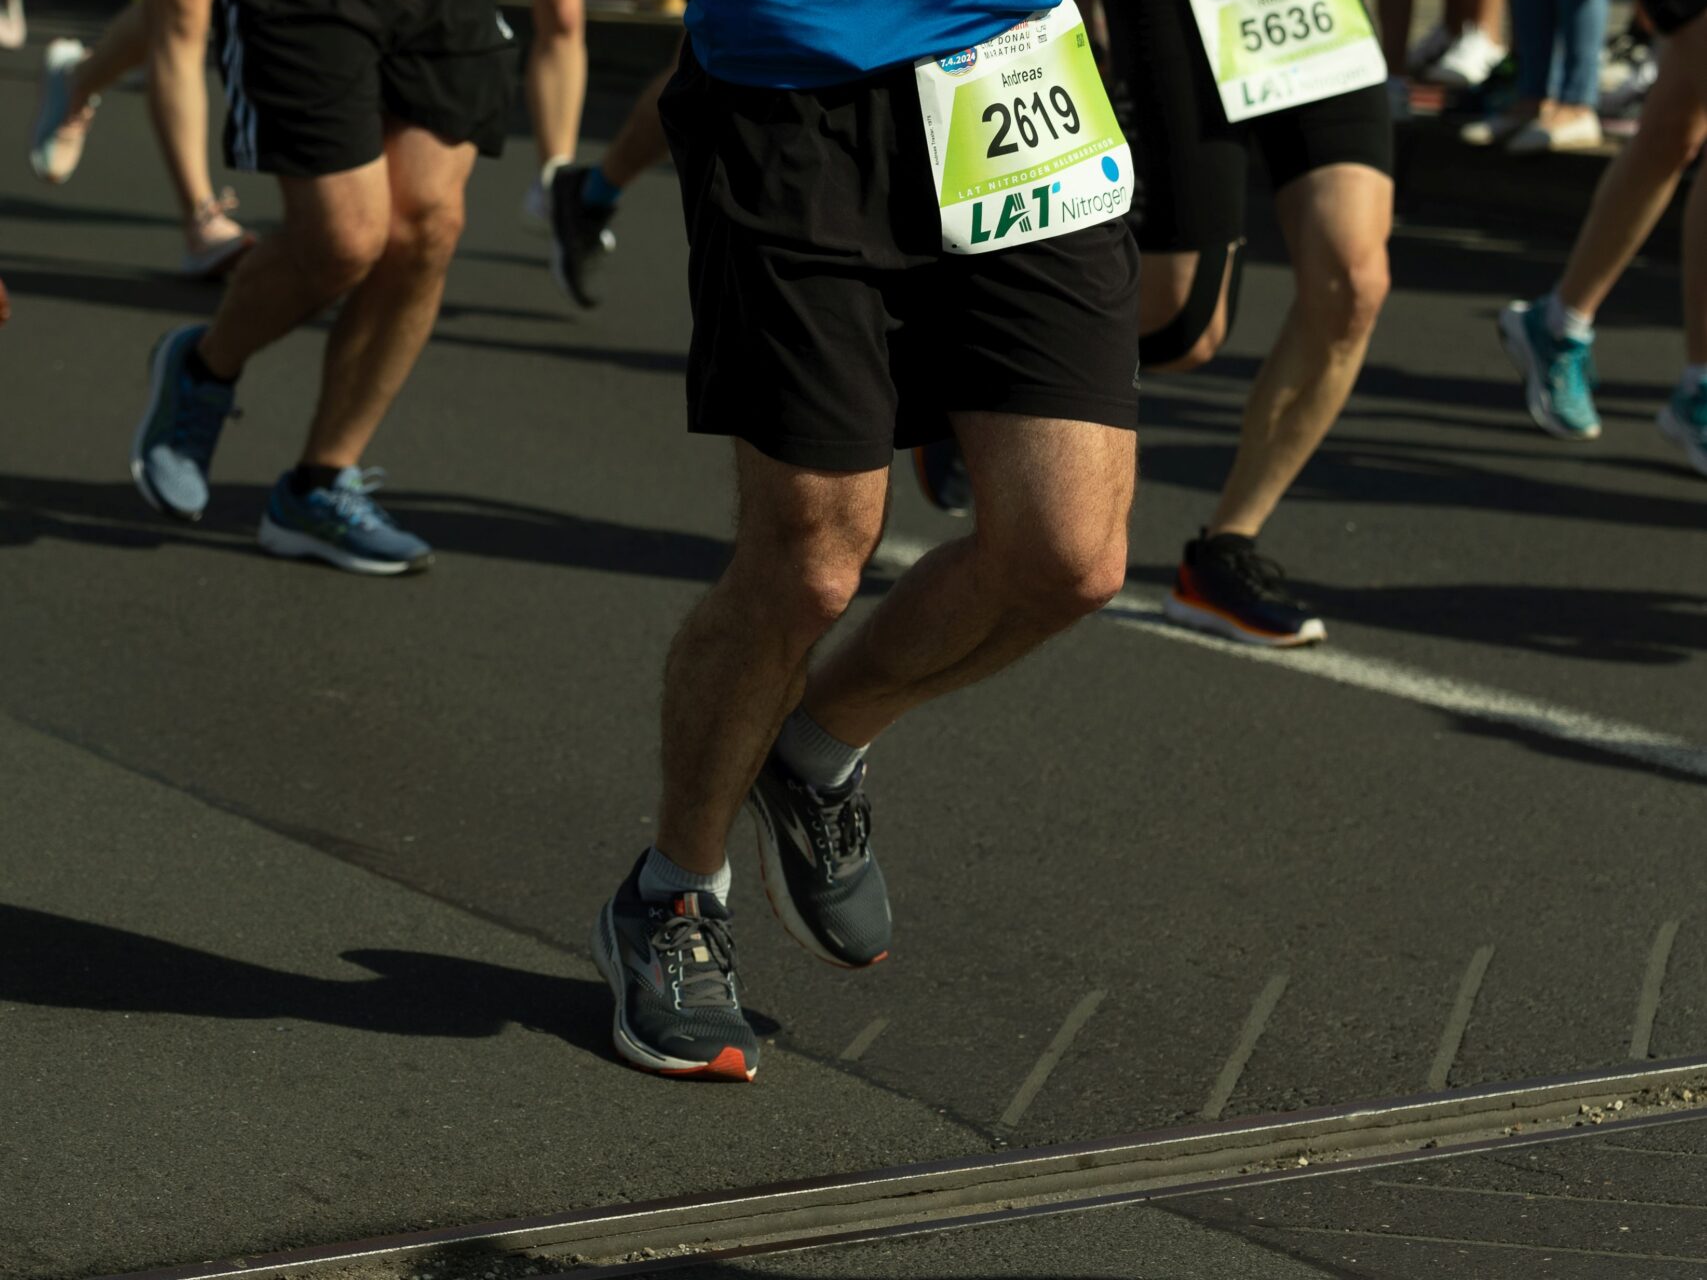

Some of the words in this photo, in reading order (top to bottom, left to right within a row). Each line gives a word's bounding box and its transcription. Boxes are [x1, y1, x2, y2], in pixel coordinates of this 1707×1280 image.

[998, 31, 1030, 45] DONAU
[1240, 1, 1334, 52] 5636
[941, 52, 976, 67] 7.4.2024
[983, 42, 1031, 59] MARATHON
[1001, 67, 1043, 88] Andreas
[982, 85, 1080, 158] 2619
[958, 185, 981, 199] LAT
[988, 164, 1050, 191] NITROGEN
[971, 184, 1051, 245] LAT
[1061, 186, 1127, 224] Nitrogen
